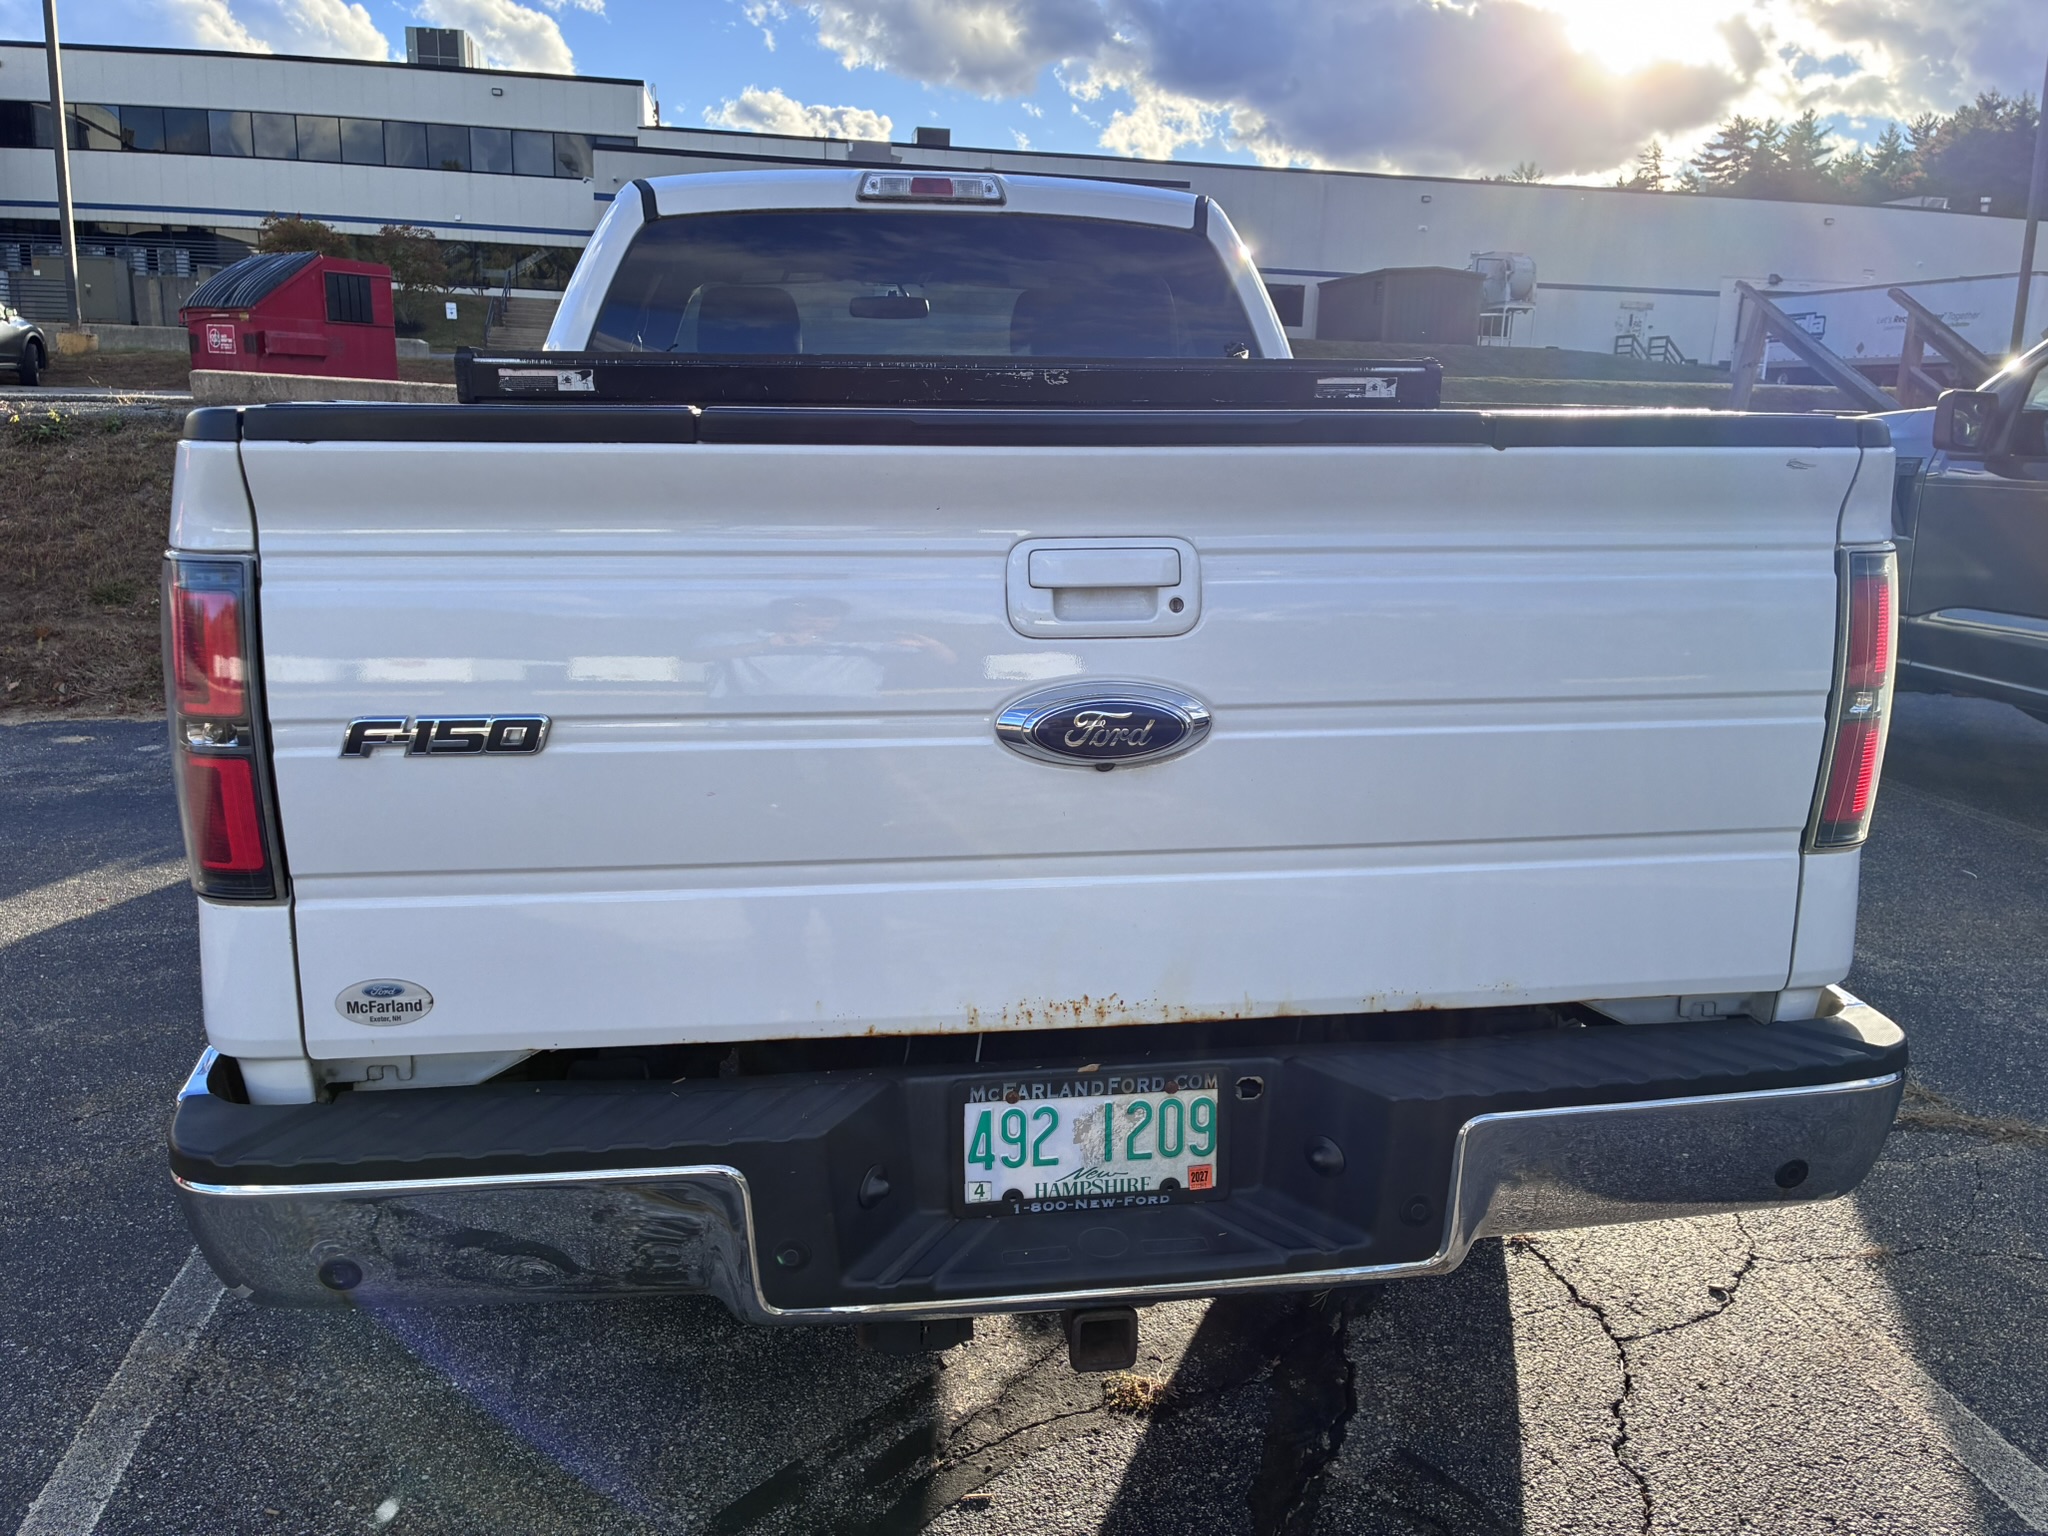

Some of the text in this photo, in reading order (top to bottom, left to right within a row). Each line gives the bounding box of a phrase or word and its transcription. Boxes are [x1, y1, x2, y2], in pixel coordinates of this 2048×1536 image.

[338, 714, 553, 759] F-150
[1065, 710, 1156, 747] Ford
[370, 985, 396, 996] Ford
[346, 999, 423, 1014] McFarland
[968, 1097, 1216, 1170] 492 1209
[1055, 1166, 1129, 1182] New
[1190, 1170, 1209, 1183] 2027
[974, 1183, 986, 1198] 4
[1035, 1176, 1152, 1199] HAMPSHIRE
[1013, 1195, 1171, 1214] 1-800-NEW-FORD
